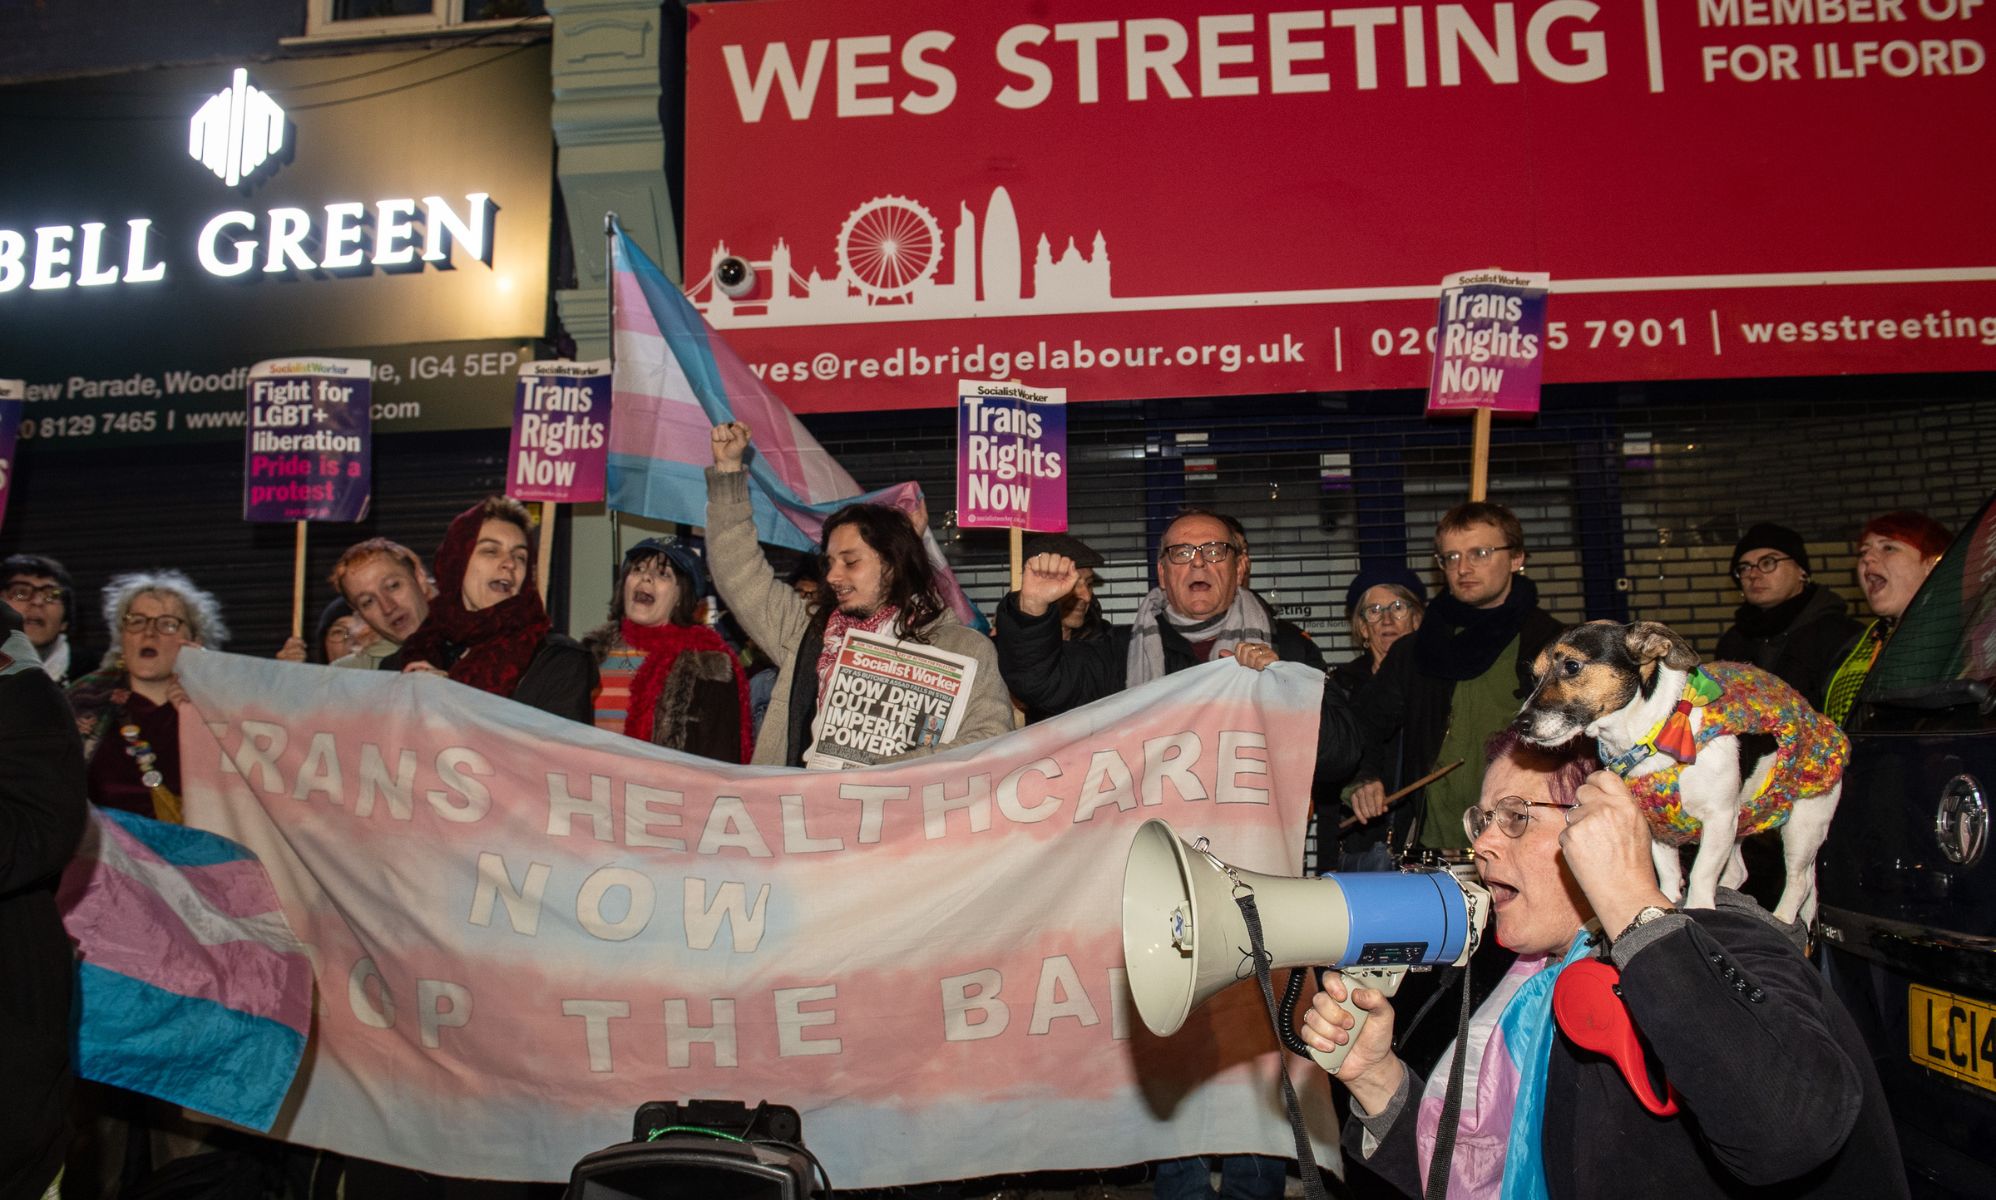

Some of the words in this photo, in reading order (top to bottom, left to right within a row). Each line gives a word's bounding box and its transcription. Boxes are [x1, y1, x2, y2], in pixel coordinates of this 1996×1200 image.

[1698, 0, 1906, 27] MEMBER
[722, 30, 957, 124] WES
[995, 0, 1608, 109] STREETING
[1702, 44, 1801, 82] FOR
[1813, 38, 1986, 79] ILFORD
[0, 219, 167, 293] BELL
[197, 193, 489, 277] GREEN
[1459, 275, 1497, 285] Socialist
[1498, 276, 1531, 286] Worker
[1446, 288, 1523, 322] Trans
[1444, 321, 1539, 363] Rights
[1584, 318, 1687, 349] 7901
[1741, 309, 1996, 346] wesstreeting
[67, 373, 162, 399] Parade,
[164, 366, 248, 393] Woodf
[410, 355, 456, 380] IG4
[463, 351, 517, 377] 5EP
[270, 363, 311, 374] Socialist
[1441, 359, 1504, 394] Now
[254, 380, 311, 405] Fight
[318, 380, 353, 402] for
[521, 377, 593, 413] Trans
[978, 386, 1017, 397] Socialist
[1018, 388, 1048, 402] Worker
[40, 415, 96, 438] 8129
[101, 411, 157, 433] 7465
[253, 404, 328, 427] LGBT+
[964, 397, 1042, 439] Trans
[253, 430, 361, 452] liberation
[520, 413, 605, 456] Rights
[252, 454, 311, 476] Pride
[319, 455, 340, 476] is
[347, 461, 361, 477] a
[516, 450, 576, 487] Now
[969, 435, 1061, 480] Rights
[251, 480, 334, 506] protest
[968, 474, 1031, 512] Now
[1279, 606, 1311, 616] eting
[852, 653, 911, 679] Socialist
[911, 666, 959, 691] Worker
[831, 691, 876, 715] OUT
[880, 702, 919, 727] THE
[835, 674, 887, 700] NOW
[888, 686, 950, 720] DRIVE
[820, 724, 908, 756] POWERS
[826, 706, 917, 746] IMPERIAL
[546, 731, 1269, 858] HEALTHCARE
[468, 851, 771, 953] NOW
[347, 955, 474, 1049] OP
[562, 984, 843, 1073] THE
